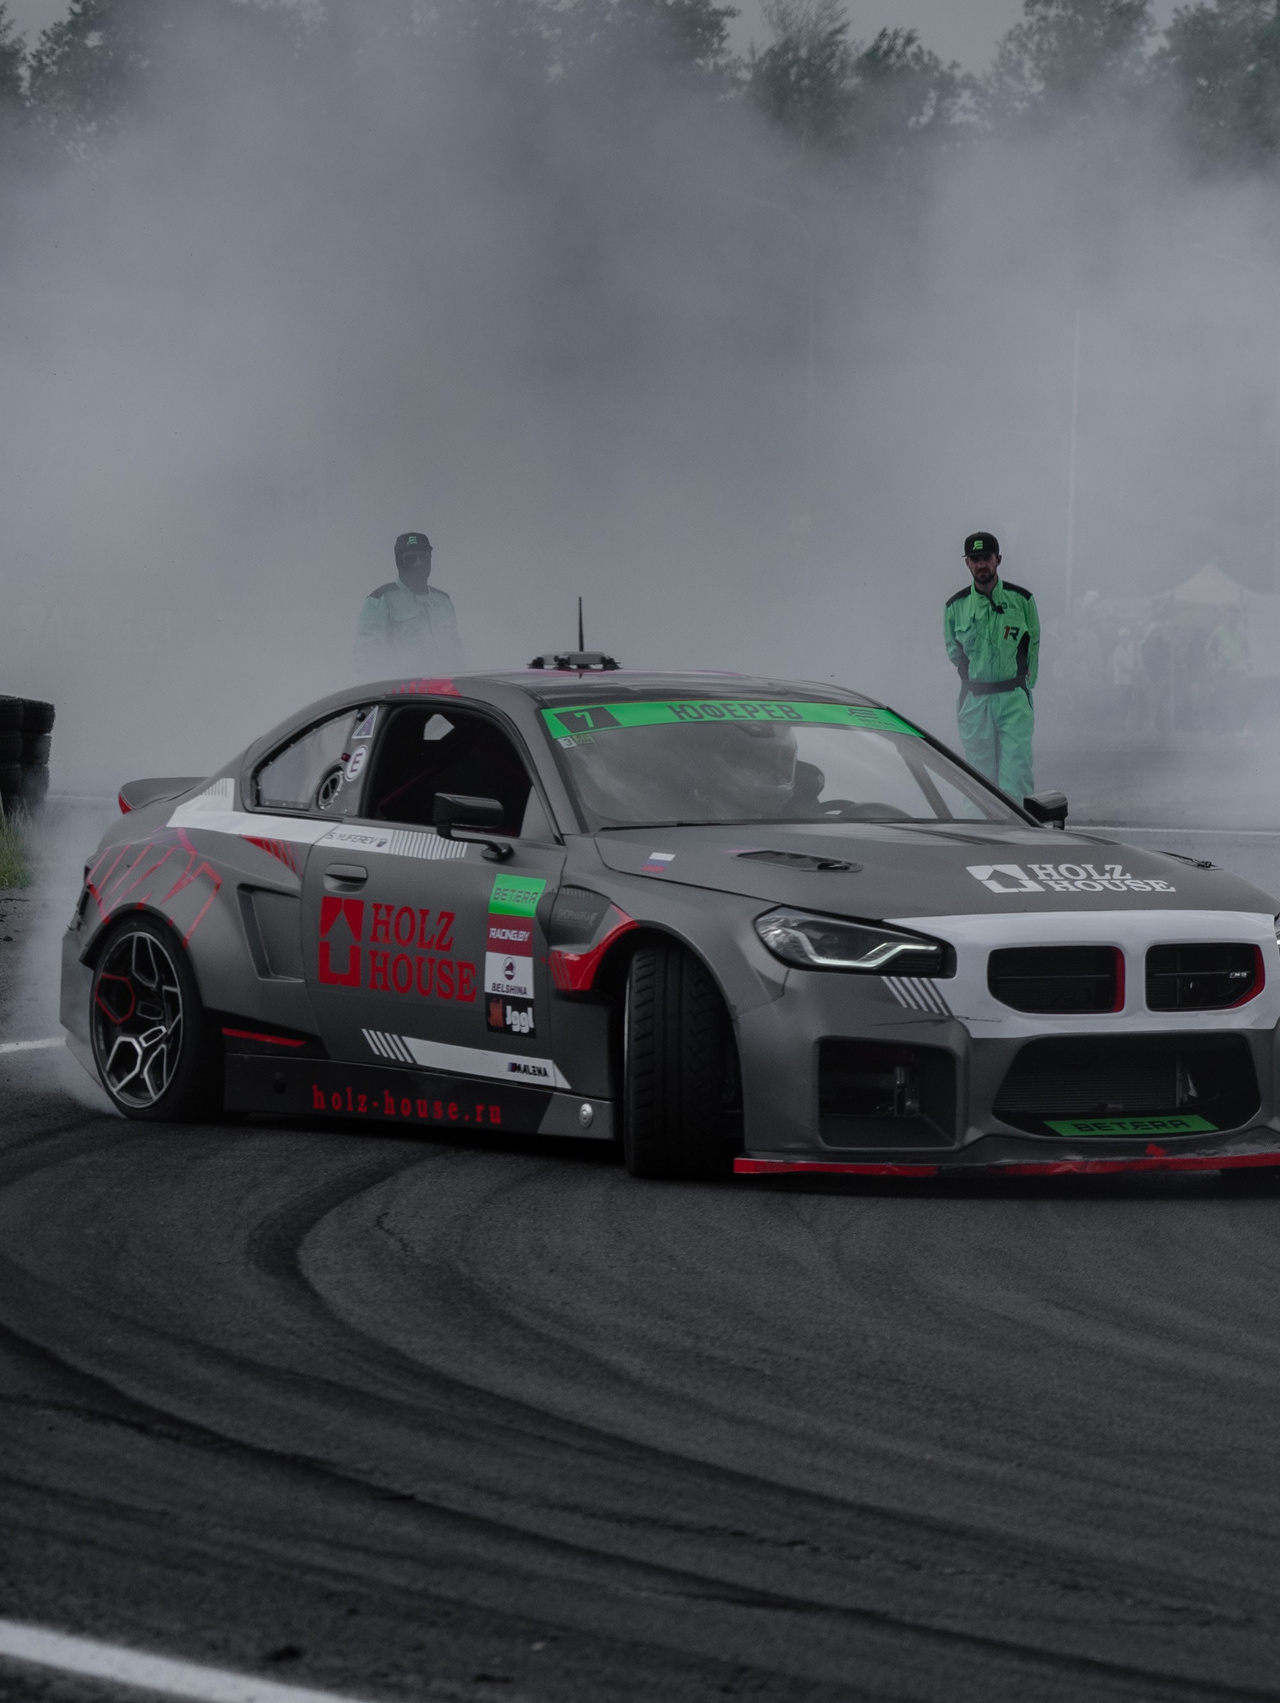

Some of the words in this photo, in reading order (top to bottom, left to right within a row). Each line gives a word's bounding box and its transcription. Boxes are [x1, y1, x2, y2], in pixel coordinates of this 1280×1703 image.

[574, 711, 594, 728] 7
[1027, 864, 1132, 880] HOLZ
[1044, 879, 1177, 893] HOUSE
[369, 902, 456, 952] HOLZ
[367, 949, 478, 1004] HOUSE
[491, 982, 528, 996] BELSHINA
[312, 1084, 502, 1124] holz-house.ru
